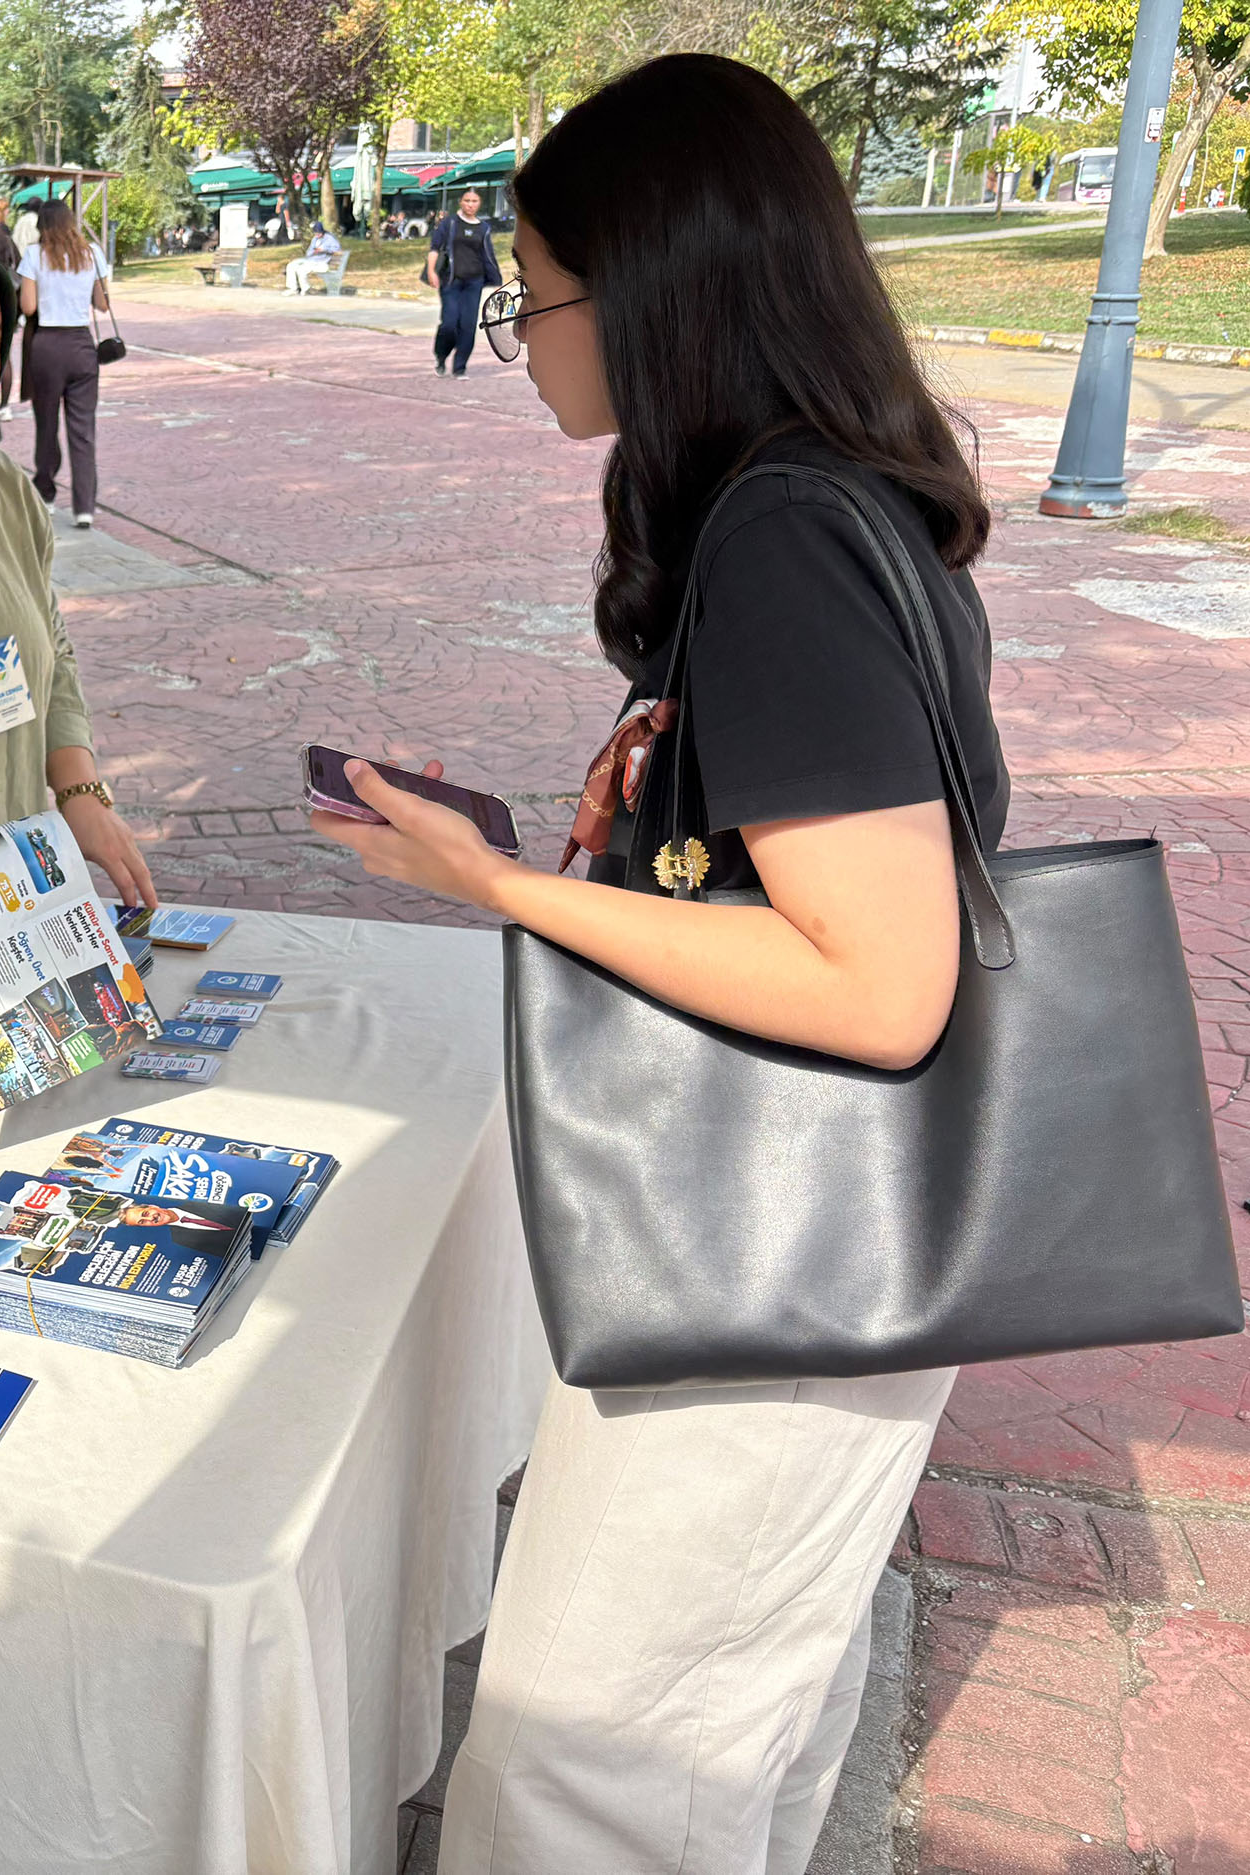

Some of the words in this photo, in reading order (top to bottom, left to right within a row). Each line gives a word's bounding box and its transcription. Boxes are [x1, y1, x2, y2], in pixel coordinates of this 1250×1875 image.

[64, 910, 83, 943] Yerinde
[72, 906, 91, 933] Şehrin
[87, 933, 99, 949] Her
[82, 901, 99, 927] Kültür
[96, 927, 105, 939] ve
[102, 939, 118, 966] Sanat
[7, 936, 25, 963] Keşfet
[17, 931, 34, 962] Öğren,
[32, 961, 45, 981] Üret
[193, 1176, 210, 1200] ŞEHRİ
[212, 1175, 227, 1202] ÖĞRENCİ
[171, 1263, 189, 1284] YUSUF
[181, 1256, 204, 1287] ALEMDAR
